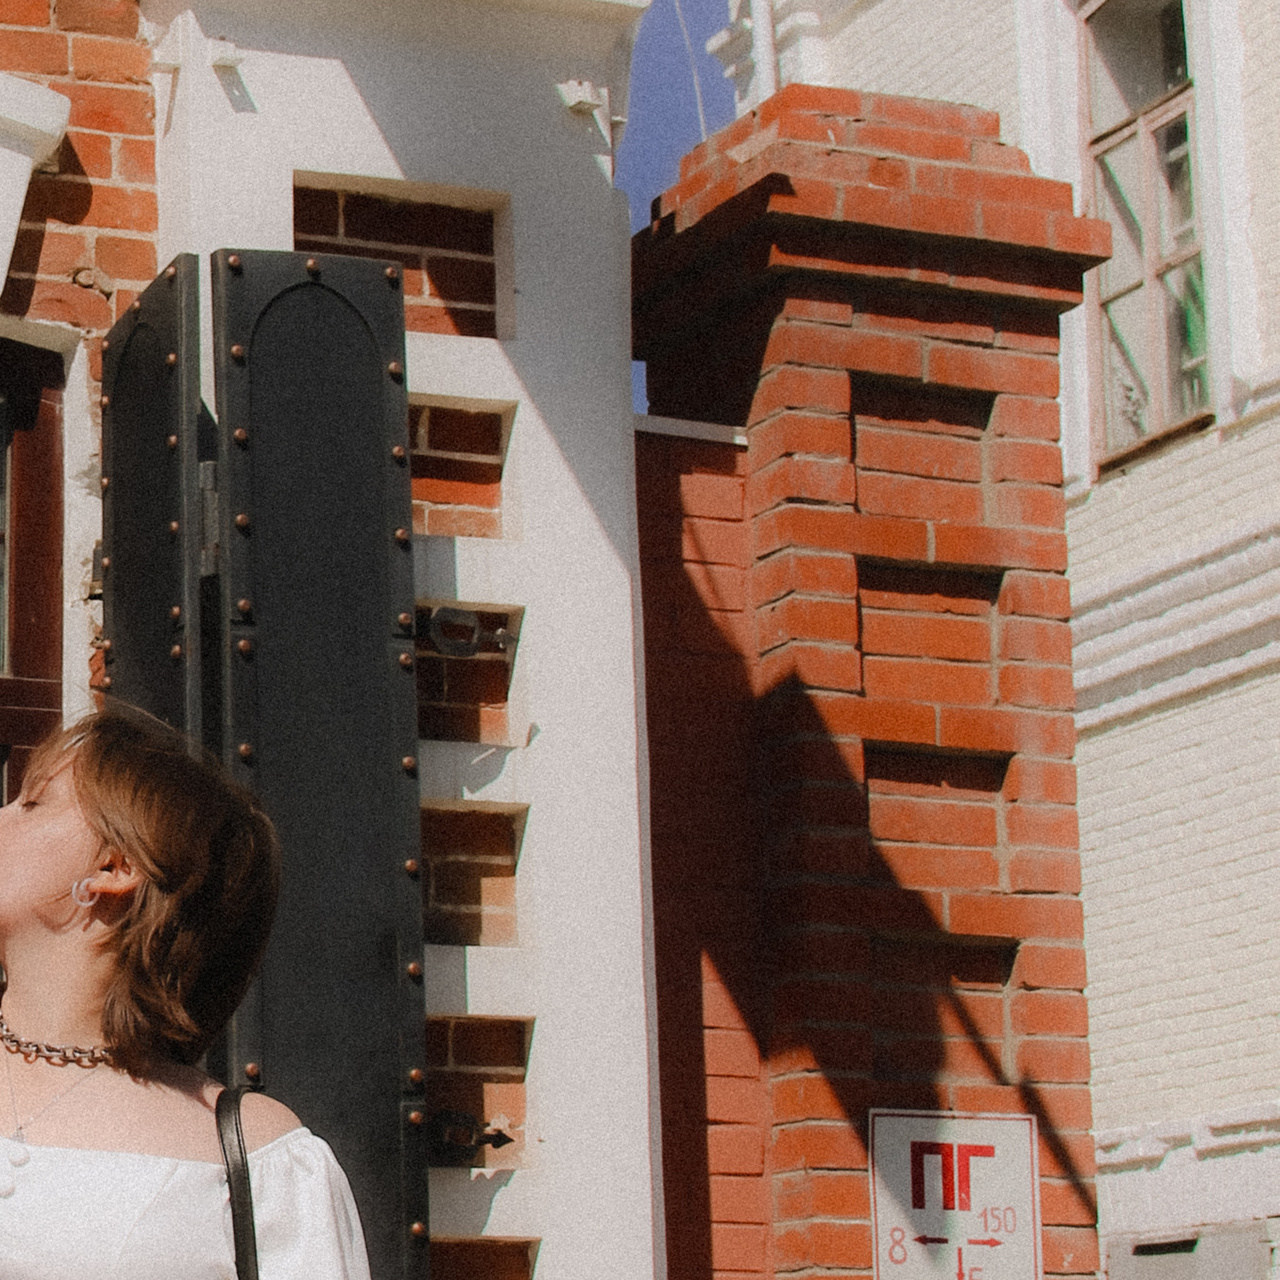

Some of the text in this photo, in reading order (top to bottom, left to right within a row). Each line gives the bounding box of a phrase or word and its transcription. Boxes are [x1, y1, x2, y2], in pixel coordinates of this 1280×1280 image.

[910, 1141, 995, 1211] ПГ
[977, 1206, 1017, 1233] 150
[888, 1227, 908, 1264] 8
